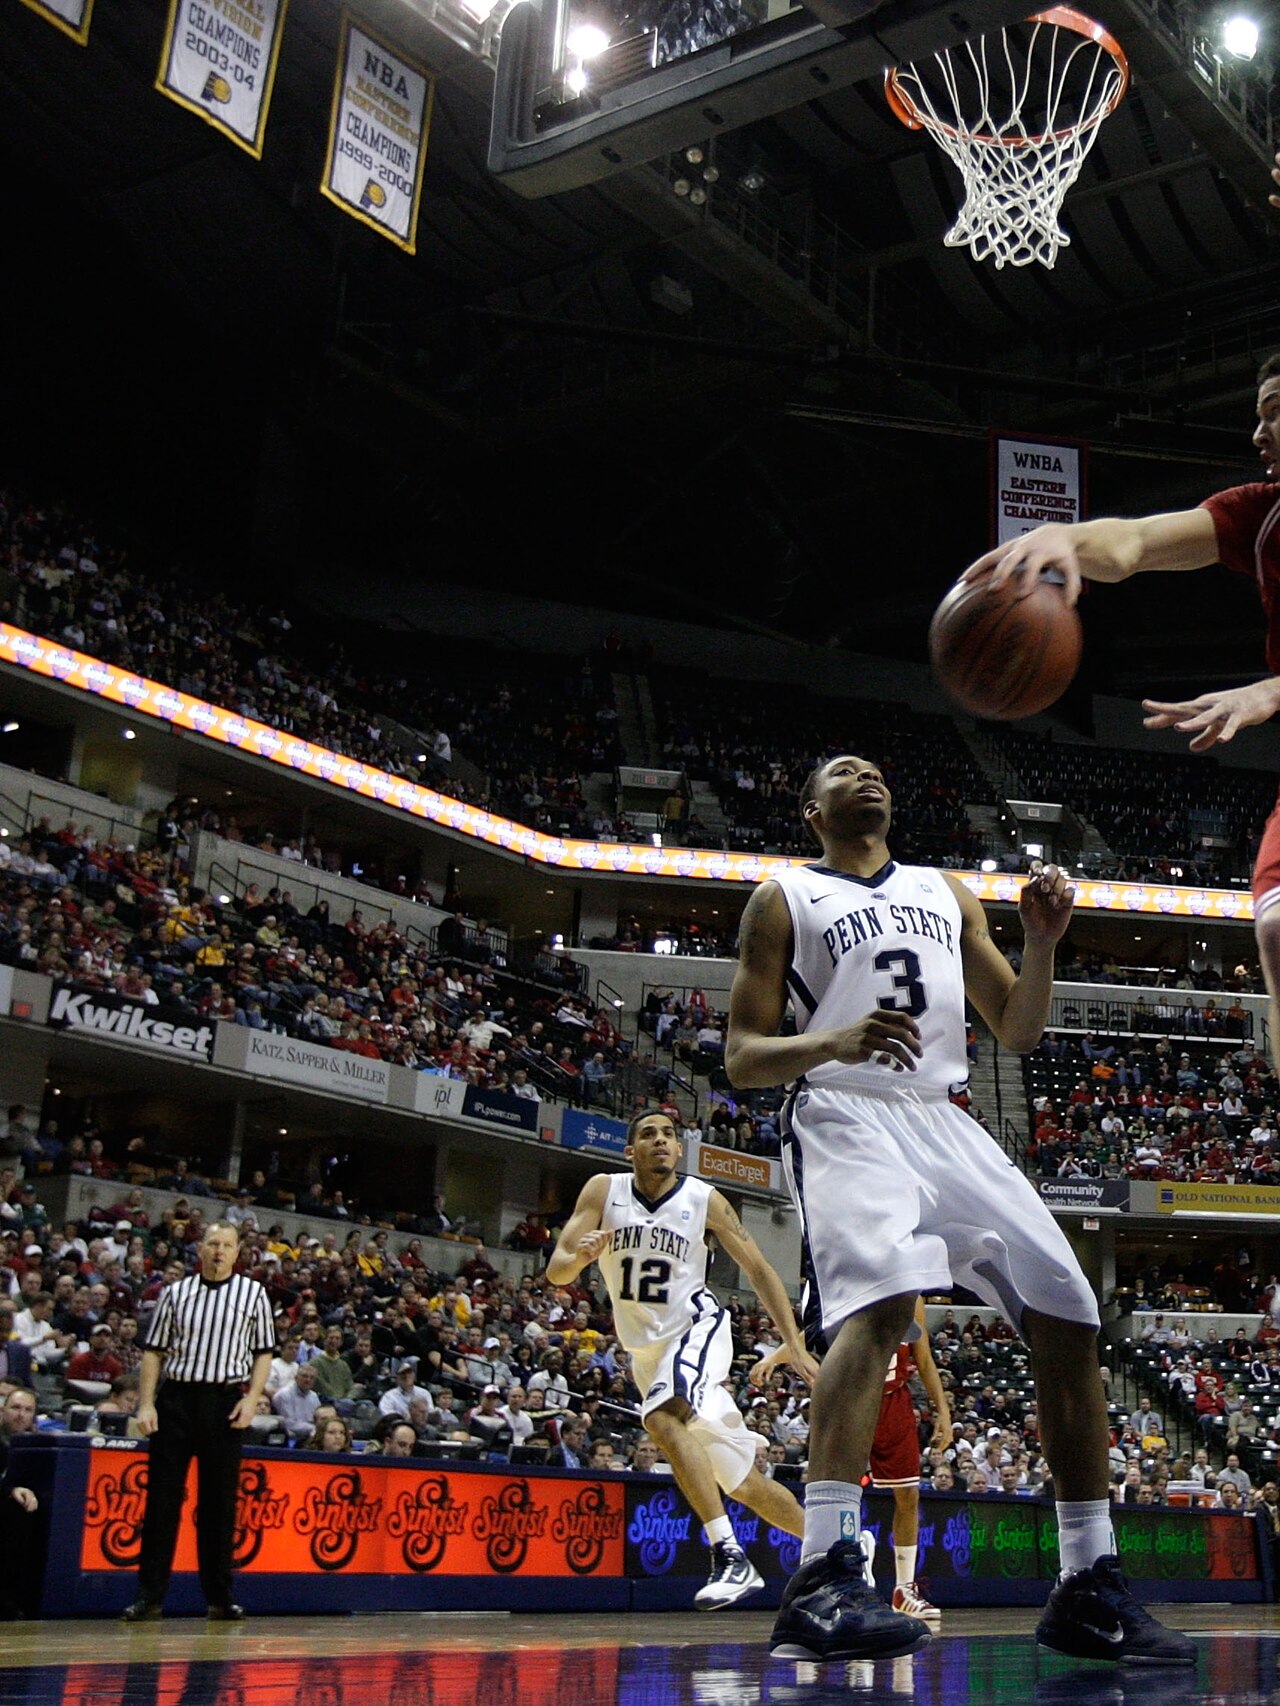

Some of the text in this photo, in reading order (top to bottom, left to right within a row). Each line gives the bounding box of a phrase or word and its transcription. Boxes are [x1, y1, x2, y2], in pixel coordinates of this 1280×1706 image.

[188, 3, 261, 69] CHAMPIONS
[186, 32, 255, 92] 2003-04
[364, 50, 409, 100] NBA
[346, 111, 411, 174] CHAMPIONS
[339, 138, 412, 197] 1999-2000
[1013, 452, 1063, 473] WNBA
[1001, 490, 1076, 510] CONFERENCE
[1011, 477, 1066, 494] EASTERN
[1004, 505, 1073, 524] CHAMPIONS
[822, 904, 955, 968] PENN STATE
[872, 947, 929, 1019] 3
[51, 988, 213, 1054] Kwikset
[330, 1058, 341, 1074] &
[344, 1061, 386, 1084] MILLER
[600, 1132, 611, 1141] AIT
[703, 1151, 766, 1183] ExactTarget
[1040, 1182, 1104, 1196] Community
[1176, 1193, 1198, 1202] OLD
[1201, 1193, 1252, 1204] NATIONAL
[619, 1256, 671, 1304] 12
[106, 1439, 138, 1448] ANC
[295, 1486, 382, 1535] Sunkist
[386, 1490, 469, 1538] Sunkist
[472, 1495, 548, 1542] Sunkist
[553, 1499, 623, 1543] Sunkist
[628, 1504, 692, 1544] Sunkist
[994, 1520, 1034, 1550] Sunkist
